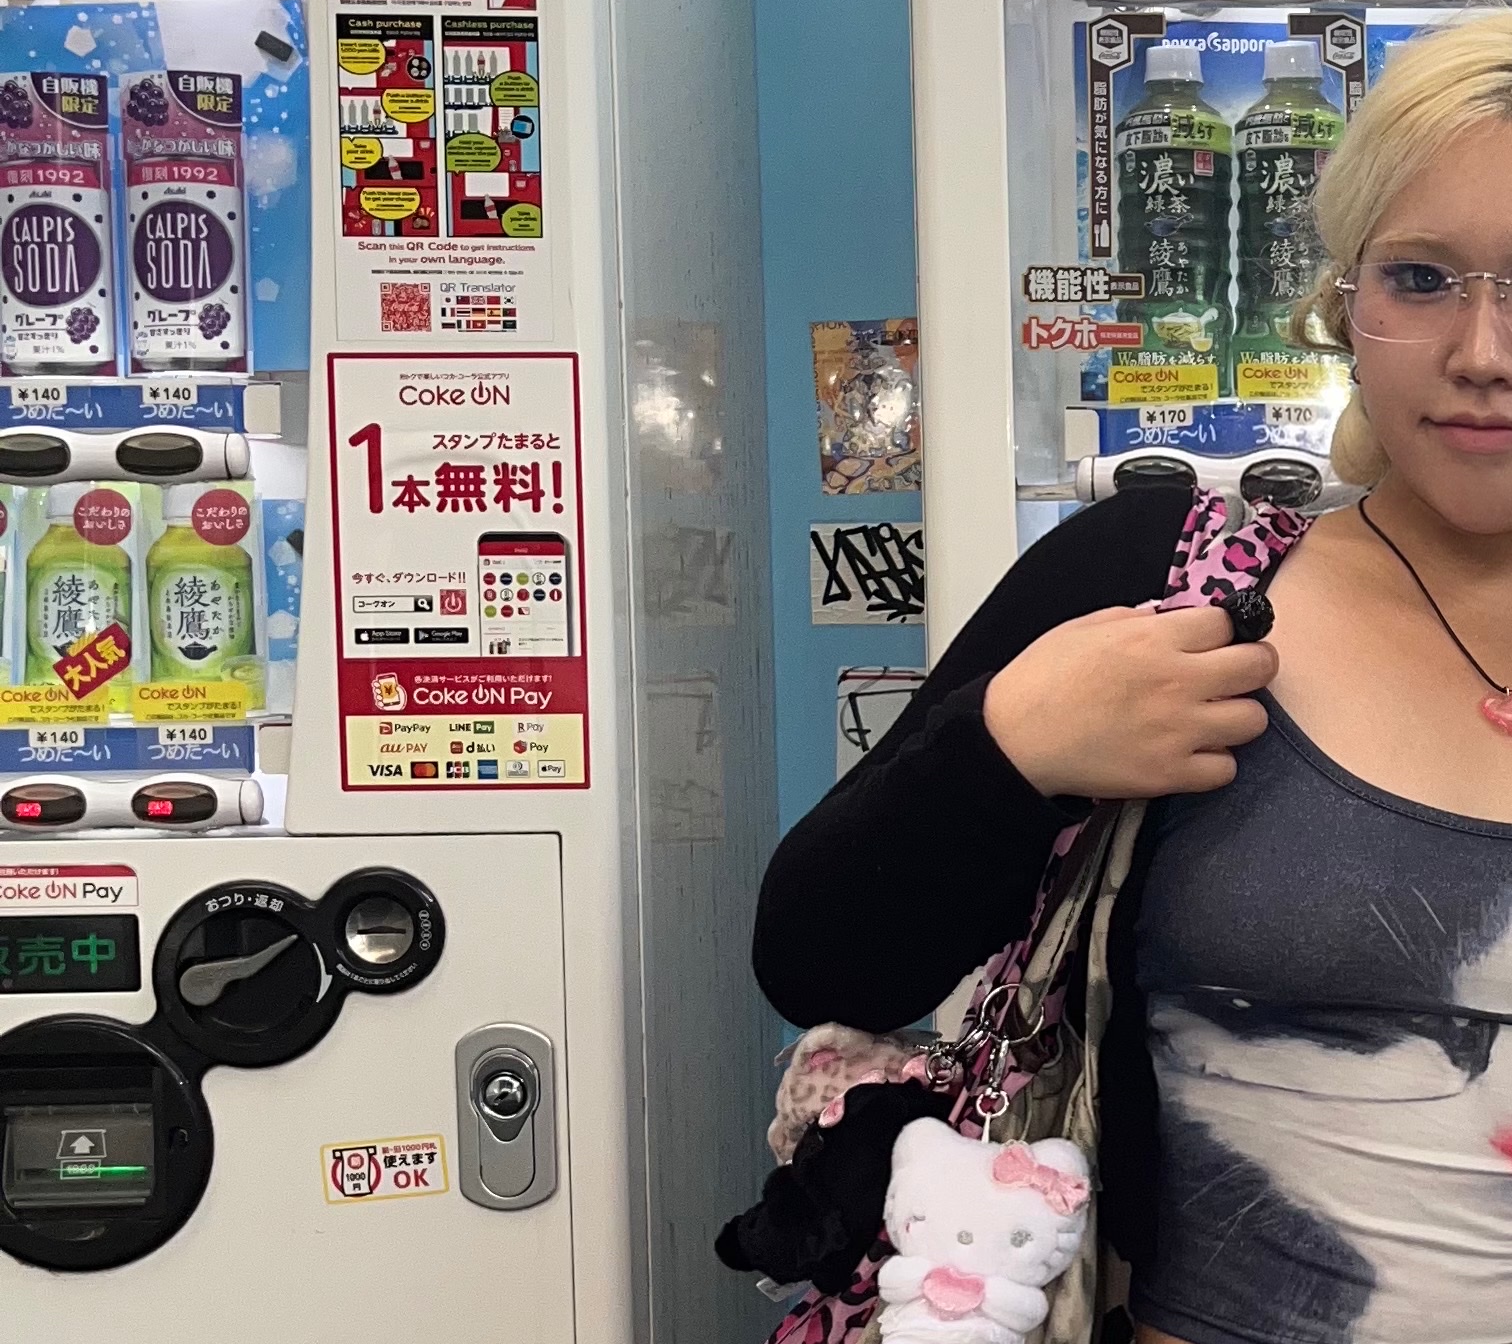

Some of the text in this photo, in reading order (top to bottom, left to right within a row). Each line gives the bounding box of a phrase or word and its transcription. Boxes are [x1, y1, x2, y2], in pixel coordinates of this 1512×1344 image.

[348, 18, 422, 30] Cash purchase
[444, 20, 534, 30] Cashless purchase
[61, 96, 99, 114] 限定
[1094, 81, 1108, 214] 脂肪が気になる方に
[1139, 153, 1195, 196] 濃い
[1145, 195, 1191, 214] 緑茶
[11, 215, 76, 244] CALPIS
[145, 213, 209, 240] CALPIS
[12, 245, 81, 294] SODA
[146, 241, 214, 290] SODA
[1149, 238, 1175, 297] 綾鷹
[440, 282, 516, 294] QR Translator
[1028, 271, 1111, 301] 機能性
[14, 314, 61, 327] グレープ
[1027, 318, 1100, 349] トクホ
[1113, 365, 1179, 383] Coke ON
[1146, 408, 1186, 423] ¥170
[433, 434, 560, 449] スタンプたまると
[349, 422, 565, 514] 1本無料!
[196, 507, 247, 518] こだわりの
[358, 600, 396, 608] コークオン
[413, 684, 552, 710] Coke ON Pay
[394, 723, 431, 733] PayPay
[449, 723, 493, 732] LINE Pay
[405, 743, 428, 752] PAY
[466, 741, 495, 753] d払い
[367, 763, 403, 776] VISA
[0, 880, 123, 903] oke ON Pay
[384, 1152, 437, 1168] 使えます
[346, 1172, 365, 1181] 1000
[394, 1168, 429, 1188] OK
